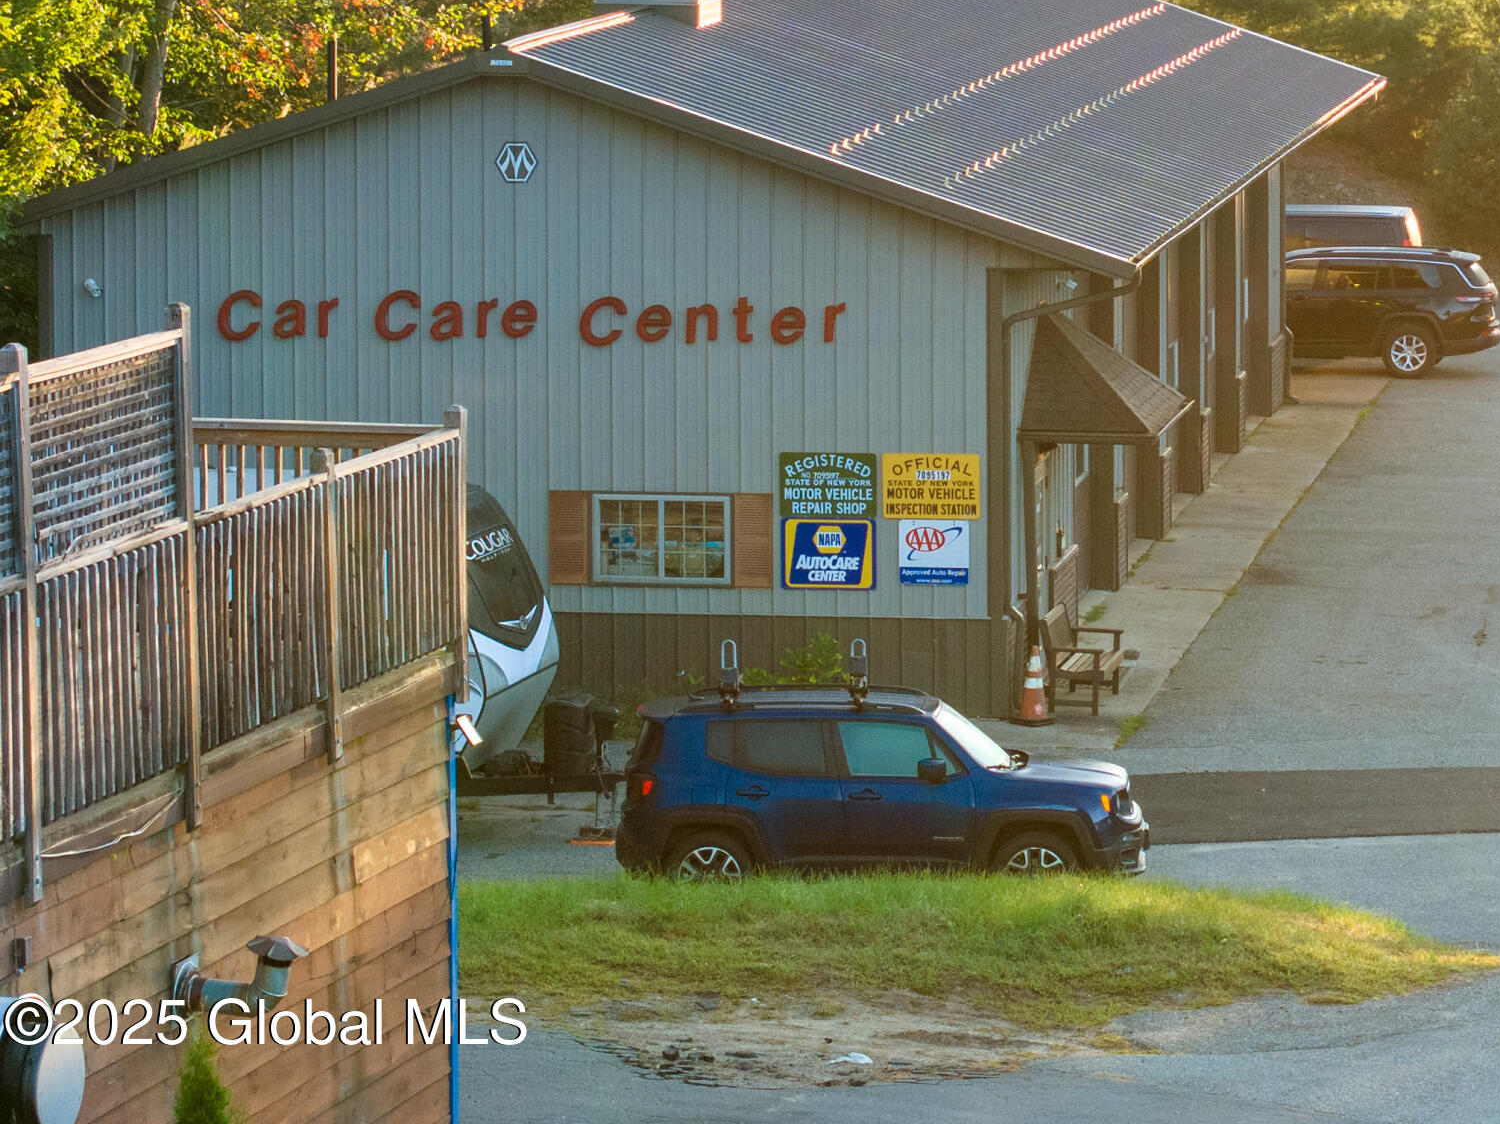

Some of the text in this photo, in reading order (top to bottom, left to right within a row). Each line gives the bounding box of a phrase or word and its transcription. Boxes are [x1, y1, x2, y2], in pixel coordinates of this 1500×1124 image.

[217, 289, 847, 347] Car Care Center
[784, 454, 871, 477] REGISTERED
[892, 457, 972, 476] OFFICIAL
[916, 471, 950, 479] 7095197
[784, 487, 873, 500] MOTOR VEHICLE
[887, 488, 975, 500] MOTOR VEHICLE
[792, 502, 867, 515] REPAIR SHOP
[886, 503, 977, 516] INSPECTION STATION
[818, 533, 841, 546] NAPA
[909, 527, 942, 551] AAA
[808, 570, 847, 582] CENTER
[902, 569, 931, 577] Approved
